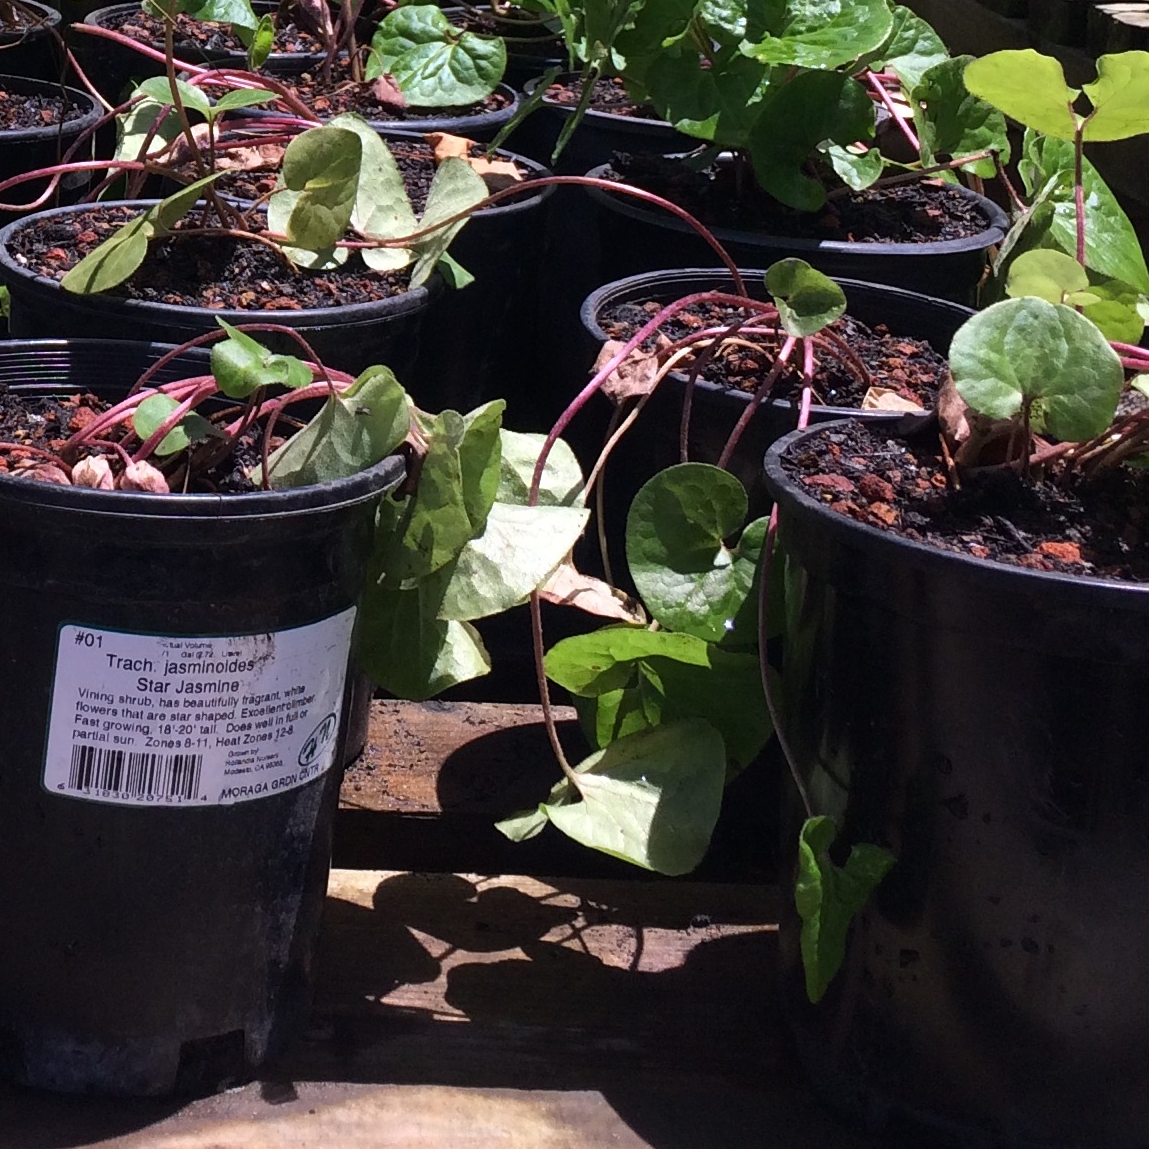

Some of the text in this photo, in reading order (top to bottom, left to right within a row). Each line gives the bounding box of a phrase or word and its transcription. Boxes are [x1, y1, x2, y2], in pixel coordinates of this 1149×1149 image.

[75, 631, 103, 648] #01
[106, 654, 156, 673] Trach.
[163, 659, 254, 676] jasminoides
[137, 677, 239, 694] Star Jasmine
[78, 687, 114, 704] Vining
[119, 695, 154, 708] shrub,
[159, 697, 180, 708] has
[183, 696, 239, 709] beautifully
[284, 685, 305, 698] white
[74, 714, 100, 727] Fast
[158, 724, 197, 735] 18'-20'
[226, 722, 252, 733] Does
[255, 717, 274, 729] well
[275, 716, 284, 725] in
[286, 712, 299, 723] full
[300, 710, 309, 719] or
[76, 701, 118, 717] flowers
[122, 708, 143, 720] that
[147, 712, 166, 721] are
[170, 712, 191, 721] star
[195, 710, 237, 724] shaped.
[241, 702, 285, 719] Excellent
[72, 729, 110, 743] partial
[145, 737, 182, 749] Zones
[184, 737, 212, 749] 8-11,
[215, 736, 241, 747] Heat
[243, 732, 273, 744] Zones
[220, 763, 320, 800] MORAGA GRDN CNTR
